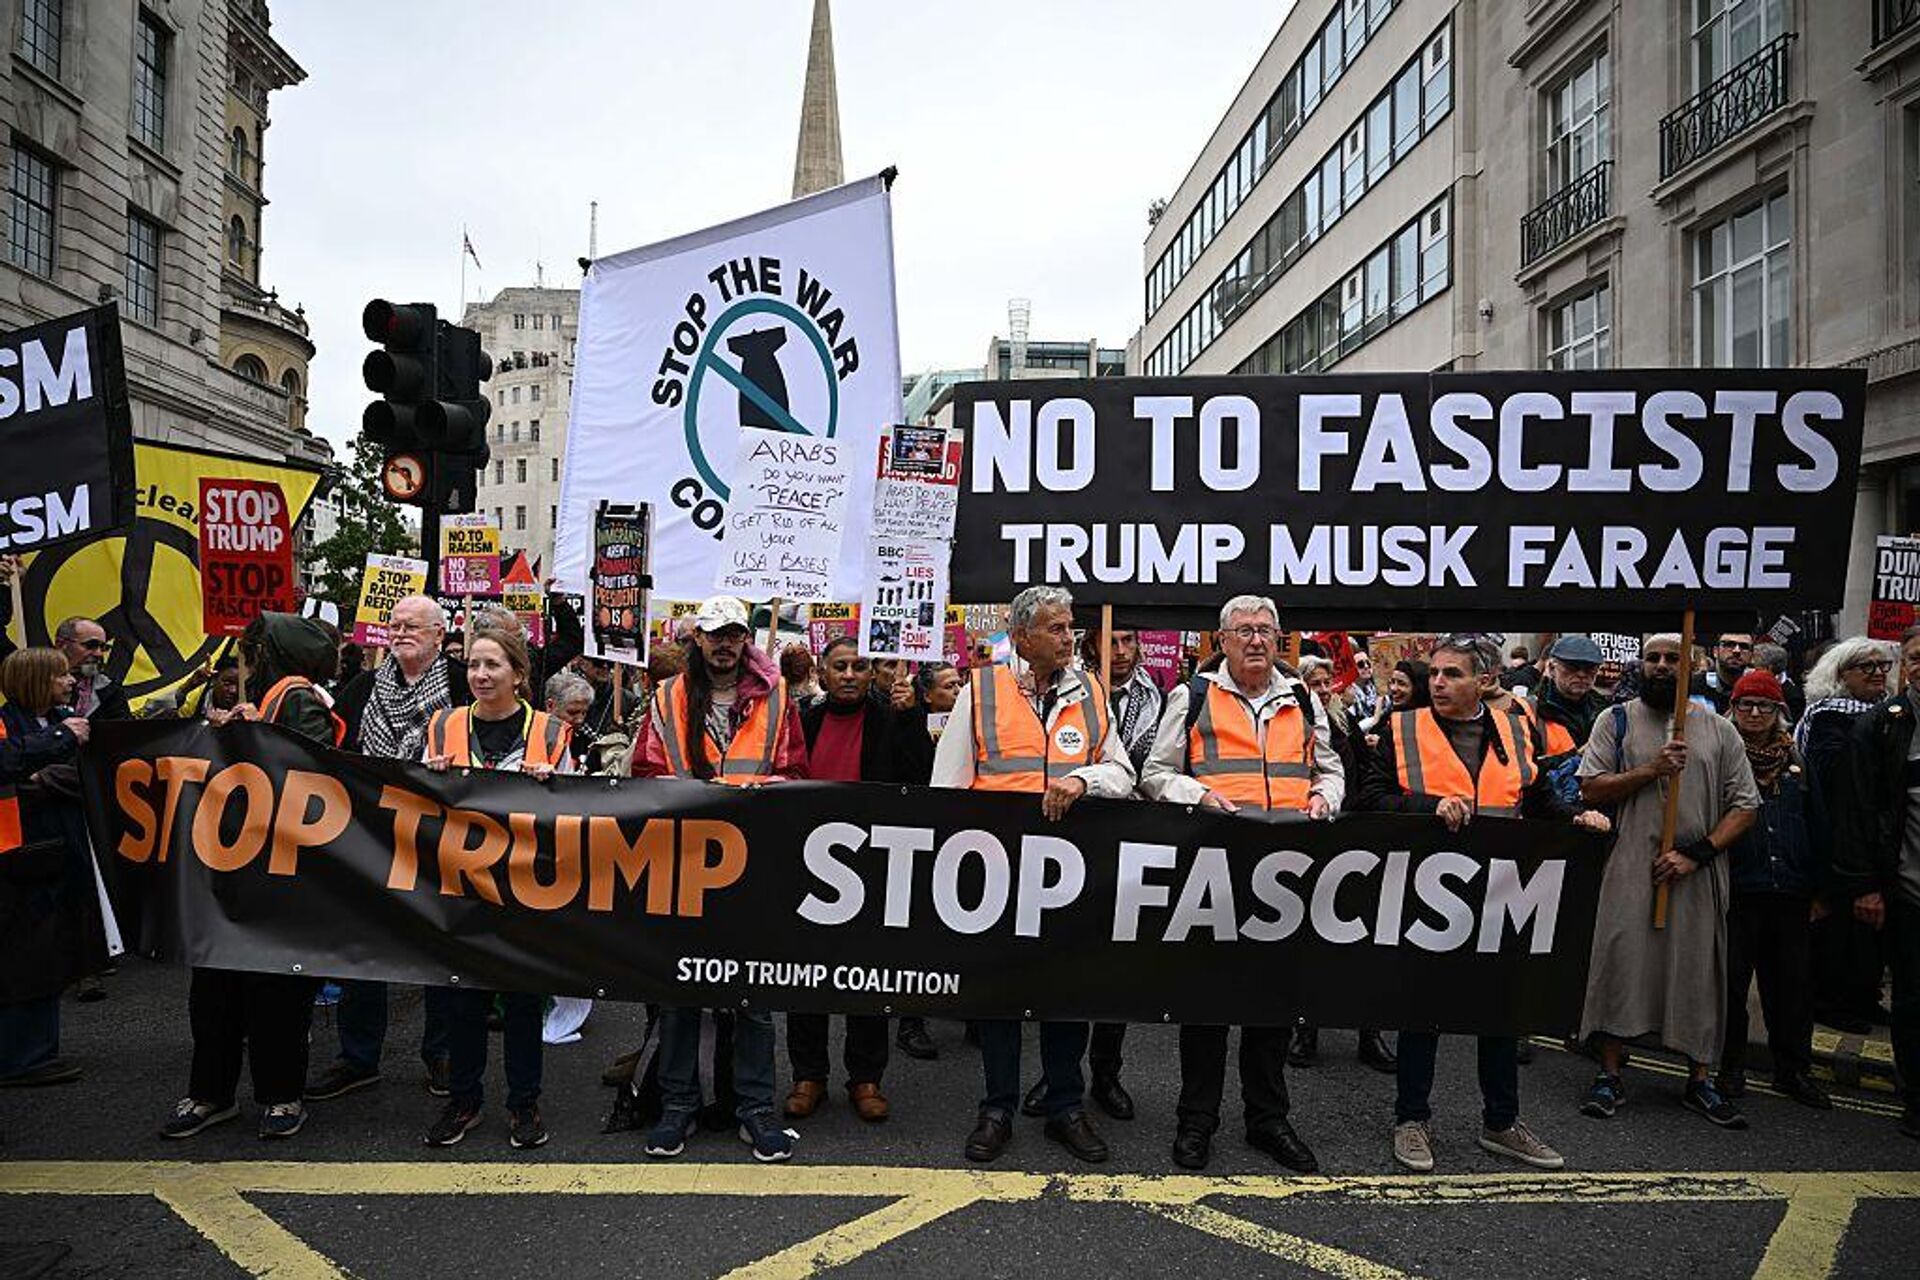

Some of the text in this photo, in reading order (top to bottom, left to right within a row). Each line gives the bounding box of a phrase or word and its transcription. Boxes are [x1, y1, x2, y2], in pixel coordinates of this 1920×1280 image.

[651, 256, 859, 408] STOP THE WAR
[972, 389, 1844, 494] NO TO FASCISTS
[749, 440, 837, 465] ARABS
[764, 468, 780, 480] DO
[0, 484, 90, 548] SM
[205, 488, 281, 525] STOP
[670, 477, 725, 541] CO
[732, 512, 839, 532] GET RID OF ALL
[206, 524, 284, 551] TRUMP
[449, 529, 483, 542] NO TO
[449, 542, 493, 554] RACISM
[878, 546, 904, 558] BBC
[1001, 523, 1796, 589] TRUMP MUSK FARAGE
[449, 557, 466, 571] NO
[780, 553, 828, 572] BASES
[1879, 550, 1920, 575] DUM
[208, 561, 285, 598] STOP
[378, 570, 411, 587] STOP
[449, 570, 465, 582] TO
[906, 567, 934, 578] LIES
[370, 582, 416, 598] RACIST
[449, 580, 492, 593] TRUMP
[1877, 574, 1920, 602] TRU
[364, 595, 399, 611] REFO
[873, 606, 918, 618] PEOPLE
[612, 609, 621, 626] IS
[1600, 647, 1640, 663] ELCOME
[115, 756, 1567, 956] STOP TRUMP STOP FASCISM
[676, 957, 960, 995] STOP TRUMP COALITION
